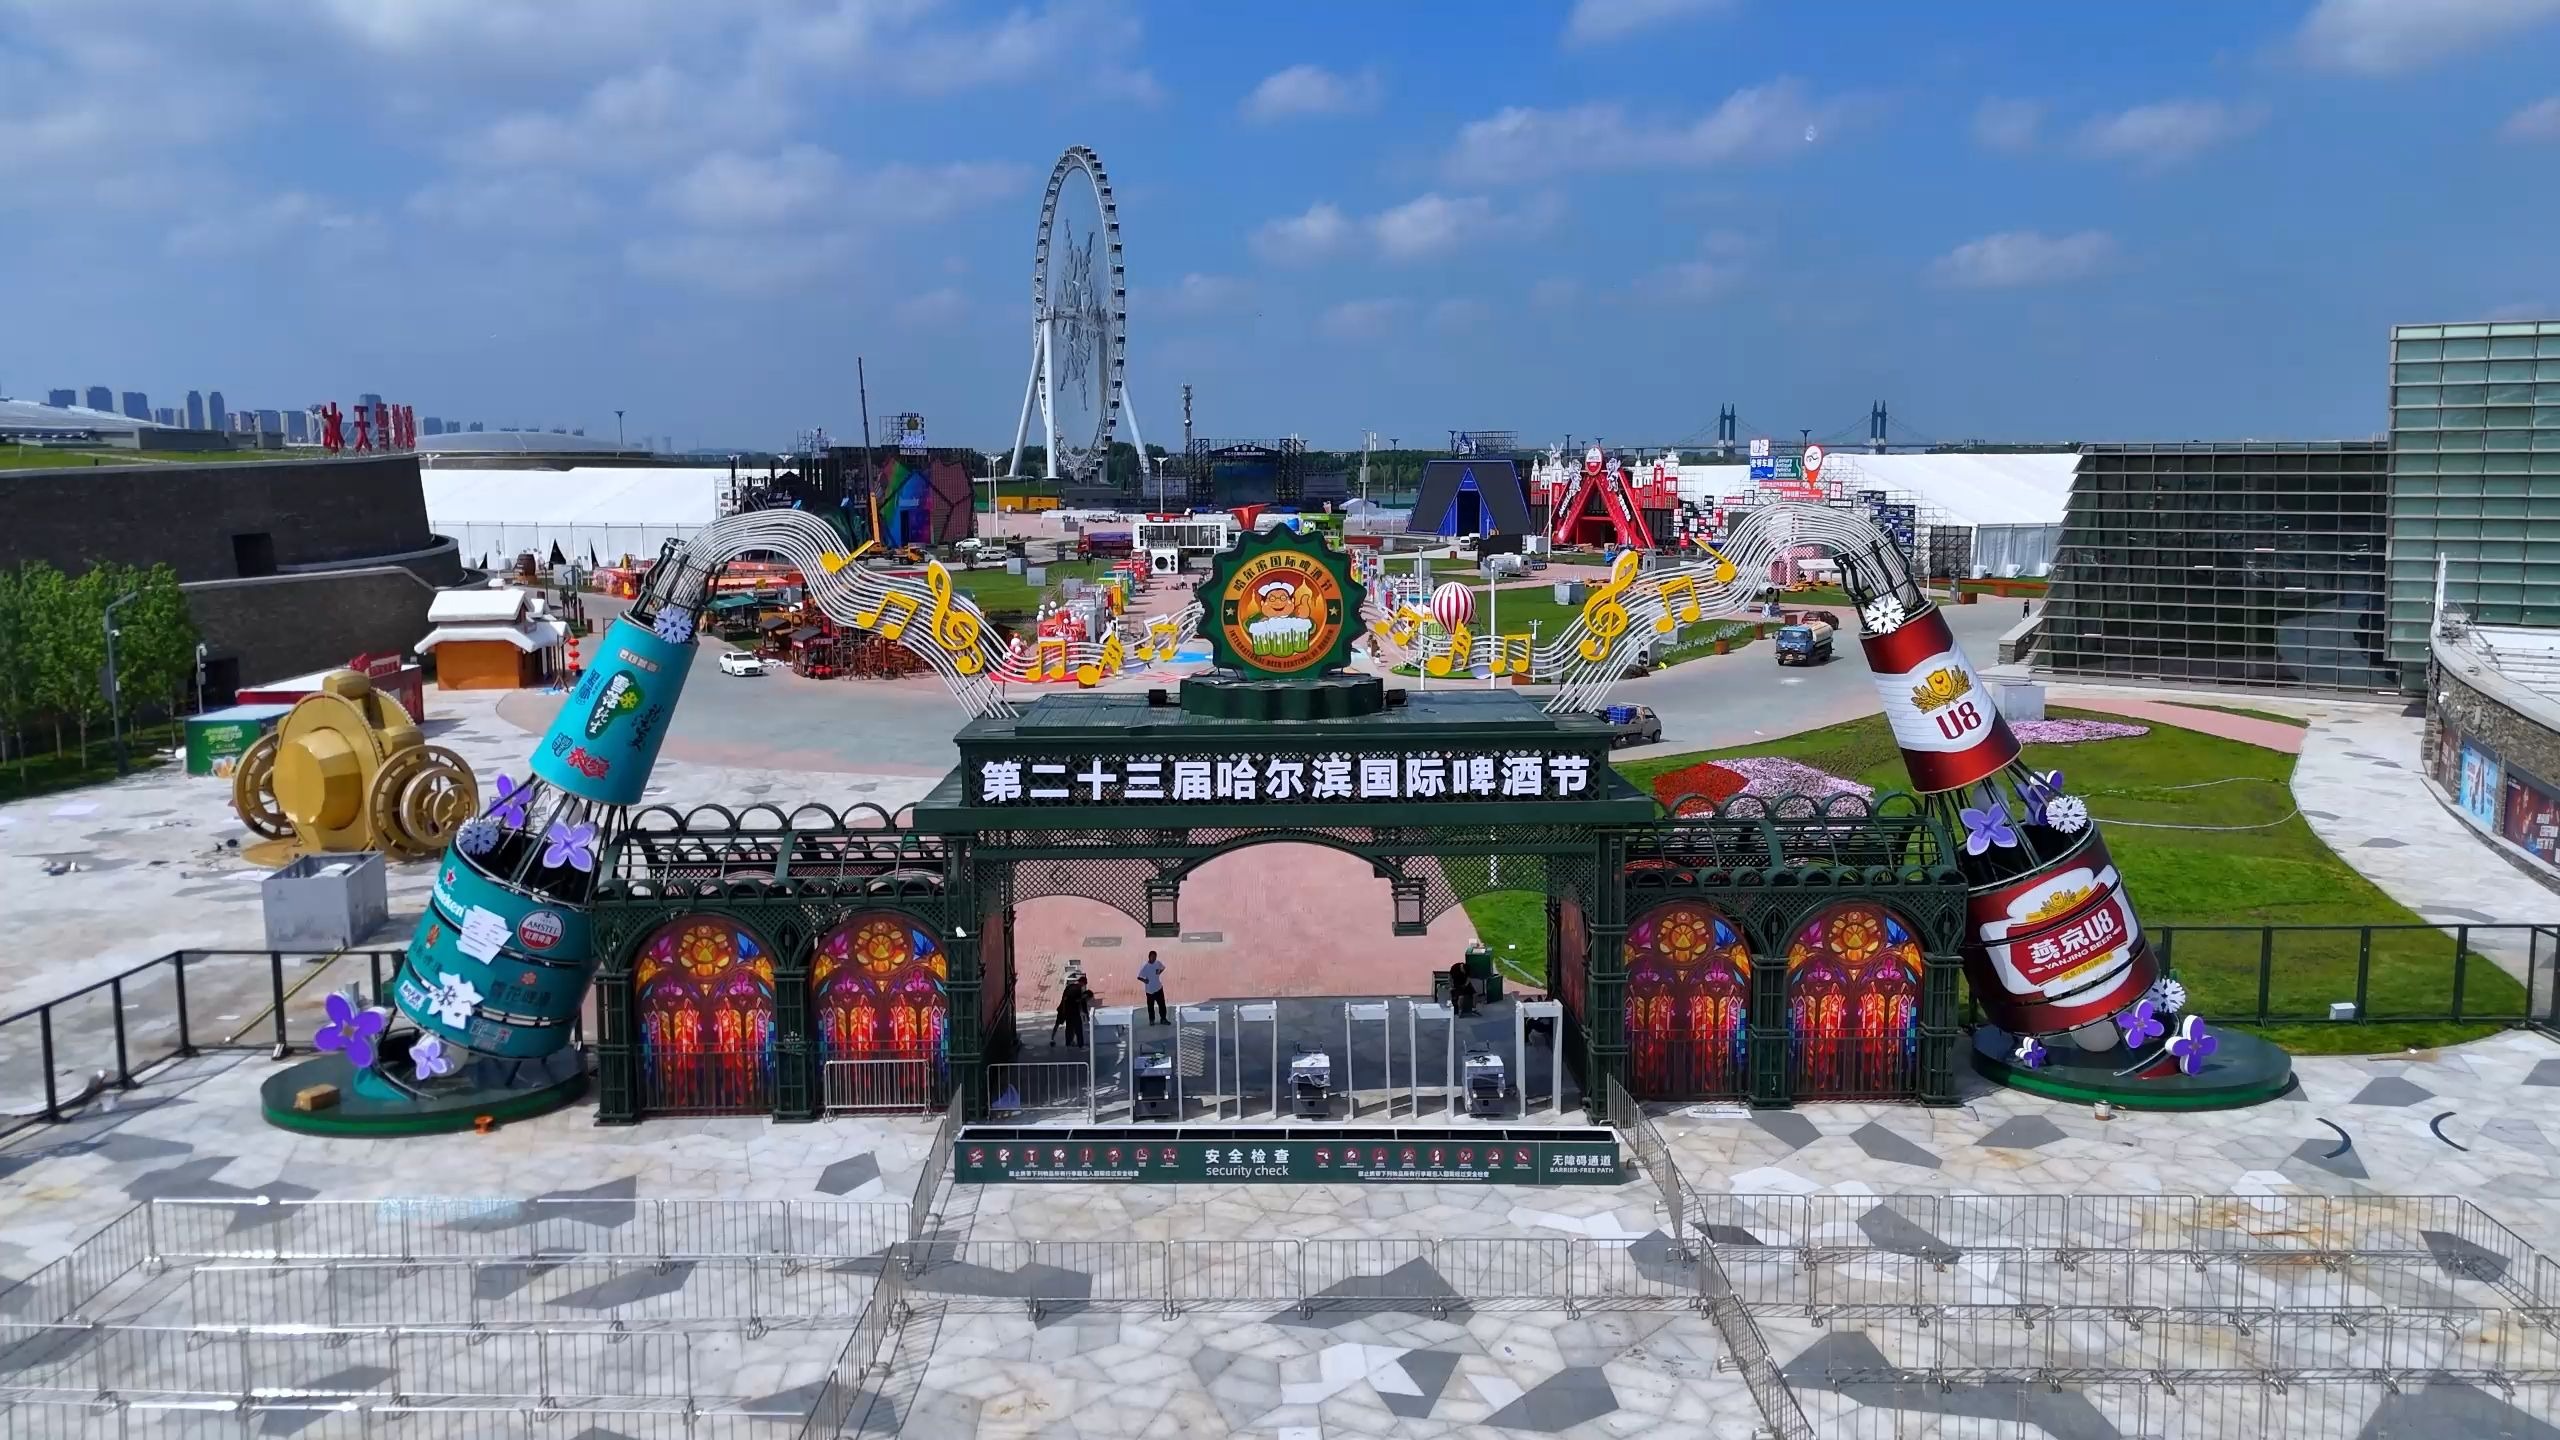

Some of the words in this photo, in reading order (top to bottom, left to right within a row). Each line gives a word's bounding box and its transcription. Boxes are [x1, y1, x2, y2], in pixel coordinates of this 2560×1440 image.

[1234, 555, 1333, 592] 哈尔滨国际啤酒节
[589, 674, 632, 734] 雪花纯生
[1935, 701, 1982, 740] U8
[981, 755, 1590, 802] 第二十三届哈尔滨国际啤酒节
[526, 920, 558, 933] AMSTEL
[2045, 949, 2090, 970] YANJING
[2089, 934, 2114, 953] BEER
[1205, 1149, 1290, 1164] 安全检查
[1206, 1164, 1252, 1178] security
[1255, 1164, 1290, 1176] check
[1552, 1155, 1612, 1166] 无障碍通道
